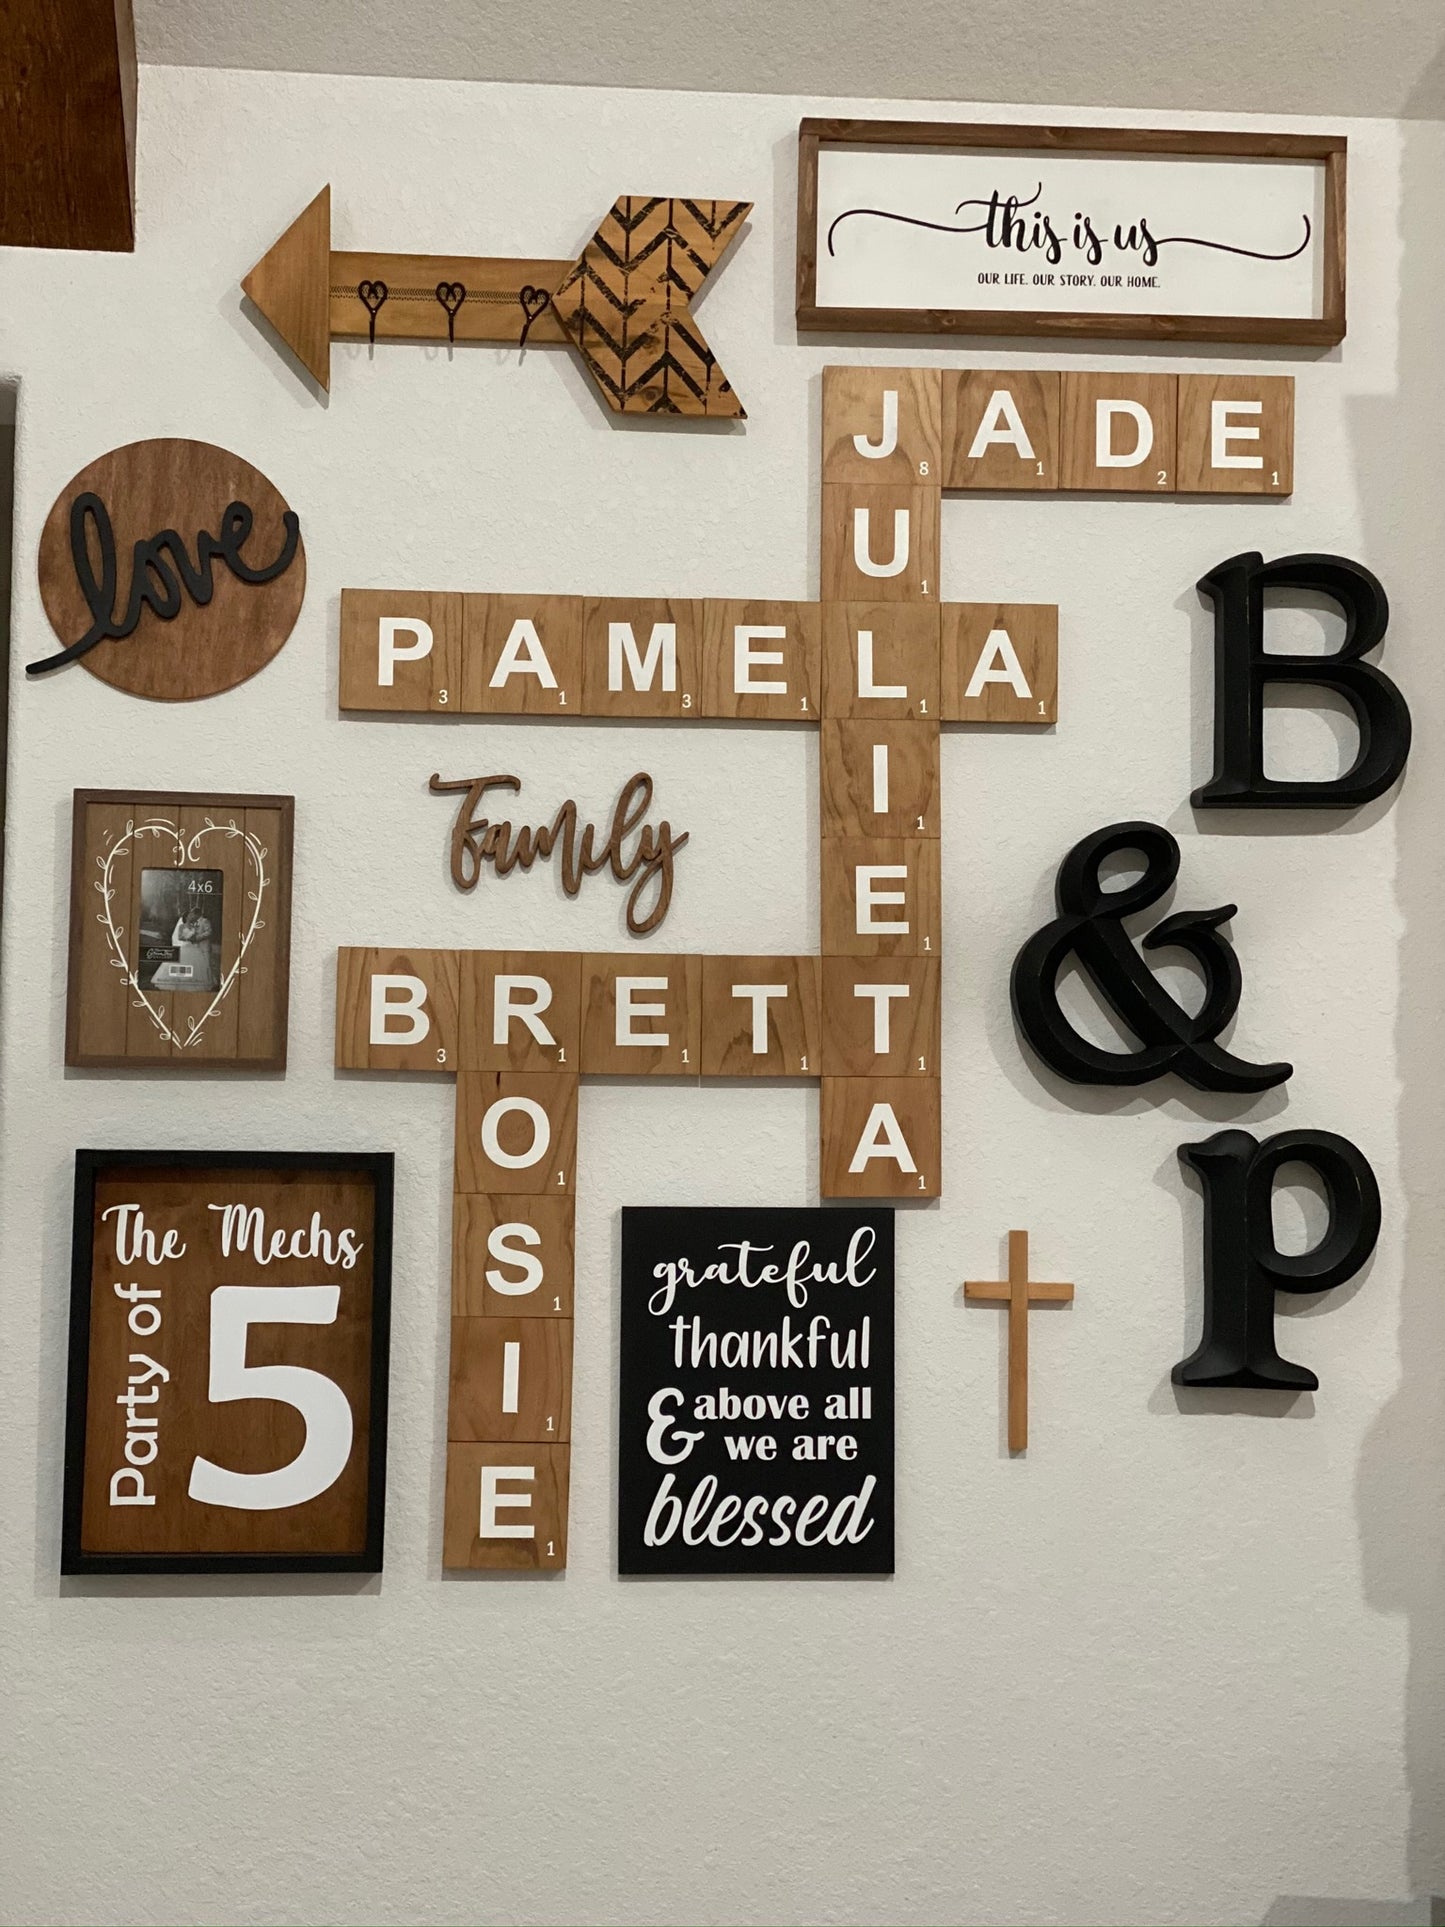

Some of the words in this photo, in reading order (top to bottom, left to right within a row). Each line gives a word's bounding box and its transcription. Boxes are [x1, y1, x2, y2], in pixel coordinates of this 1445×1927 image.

[955, 181, 1068, 265] this
[1073, 212, 1108, 266] is
[977, 272, 1000, 285] OUR
[1004, 273, 1029, 285] LIFE.
[1032, 274, 1055, 286] OUR
[1059, 274, 1097, 287] STORY.
[1100, 275, 1123, 287] OUR
[1127, 276, 1161, 289] HOME.
[852, 389, 1264, 470] JADE
[25, 491, 300, 675] love
[377, 616, 1033, 699] PAMELA
[1191, 551, 1411, 810] B
[188, 880, 213, 893] 4x6
[429, 772, 689, 938] Family
[369, 974, 910, 1054] BRETTA
[101, 1203, 187, 1266] The
[207, 1203, 364, 1270] Mechs
[648, 1226, 878, 1316] grateful
[113, 1282, 162, 1336] of
[668, 1315, 871, 1369] thankful
[109, 1353, 170, 1506] Party
[188, 1285, 353, 1511] 5
[646, 1387, 705, 1466] &
[693, 1387, 809, 1420] above
[824, 1387, 872, 1420] all
[724, 1435, 777, 1461] we
[792, 1435, 858, 1461] are
[643, 1473, 877, 1547] blessed
